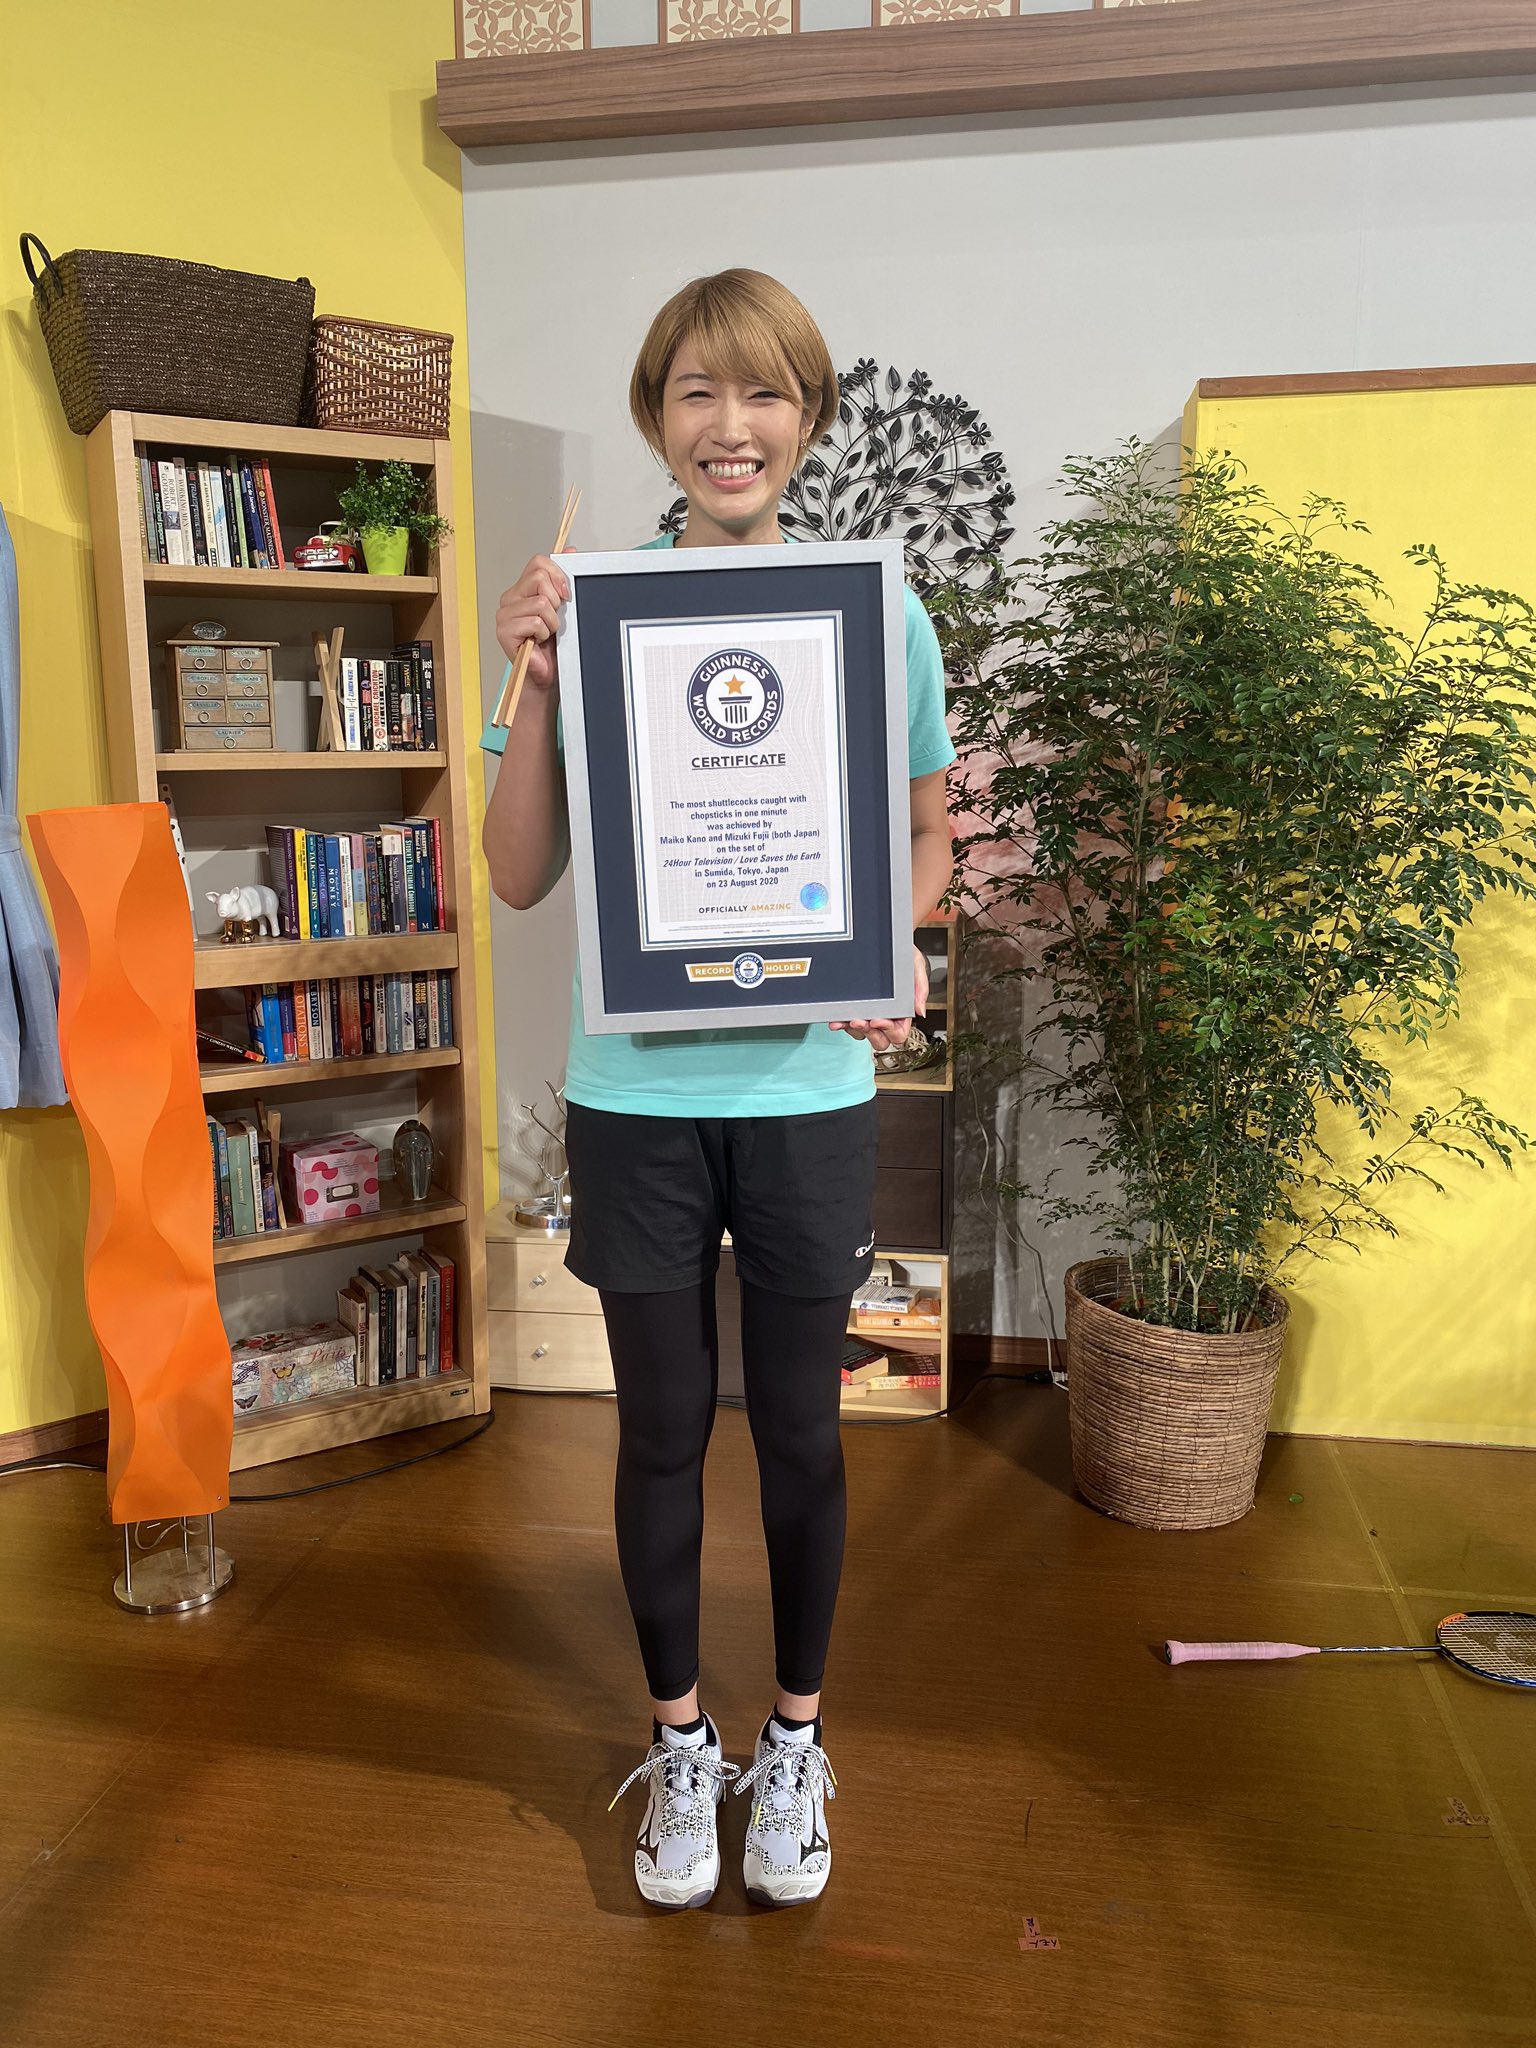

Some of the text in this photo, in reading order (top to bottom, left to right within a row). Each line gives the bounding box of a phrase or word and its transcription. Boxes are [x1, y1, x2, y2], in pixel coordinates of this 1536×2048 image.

[161, 473, 171, 510] GODDARD
[168, 478, 176, 506] ROBERT
[178, 479, 189, 528] WORKING MEN
[157, 523, 165, 544] papers
[260, 498, 274, 556] MONSTER MADNESS
[700, 654, 770, 682] GUINNESS
[391, 692, 399, 724] GARGOYLE
[692, 690, 778, 742] WORLD RECORDS
[691, 753, 786, 768] CERTIFICATE
[670, 801, 684, 809] The
[708, 797, 758, 807] shuttlecocks
[761, 796, 787, 806] caught
[788, 795, 807, 803] with
[690, 810, 733, 821] chopsticks
[735, 810, 743, 818] in
[761, 808, 787, 816] minute
[707, 821, 772, 831] was achieved by
[660, 829, 820, 844] Maiko Kano and Mizuki Fujii (both Japan)
[405, 840, 413, 863] STUDENT'S
[716, 843, 765, 854] on the set of
[663, 859, 693, 867] 24Hour
[694, 857, 733, 866] Television
[740, 855, 758, 864] Love
[760, 854, 784, 863] Saves
[786, 853, 798, 861] the
[800, 852, 821, 860] Earth
[318, 864, 326, 888] Letting
[695, 866, 789, 877] in Sumida, Tokyo, Japan
[328, 868, 336, 908] MONEY
[718, 879, 728, 888] 23
[730, 879, 758, 888] August
[760, 877, 779, 885] 2020
[320, 888, 327, 899] Go
[698, 903, 792, 914] OFFICIALLY AMAZING
[695, 964, 802, 975] RECORD HOLDER
[359, 1323, 366, 1331] 50
